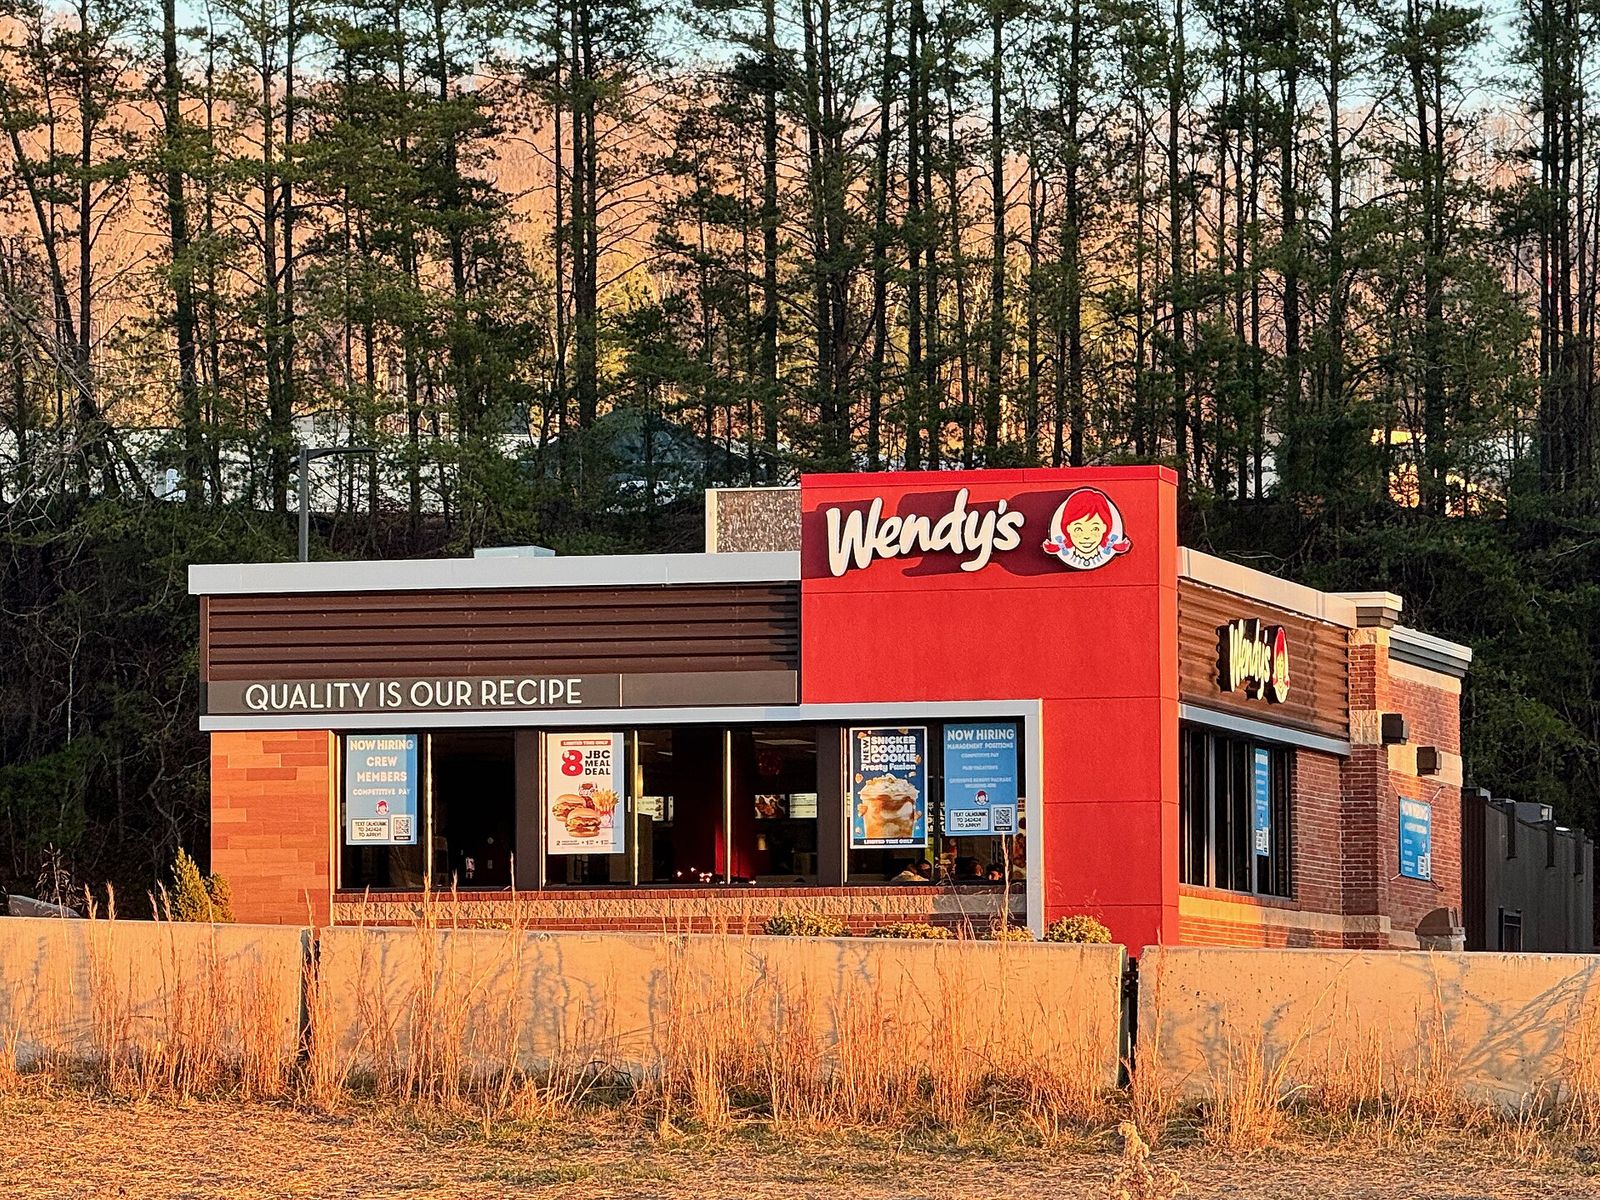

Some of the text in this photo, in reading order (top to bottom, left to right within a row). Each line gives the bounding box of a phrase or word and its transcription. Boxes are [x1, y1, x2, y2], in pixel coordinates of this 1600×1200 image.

[826, 487, 1025, 577] Wendy's
[1229, 618, 1271, 700] Wendy's
[245, 679, 582, 711] QUALITY IS OUR RECIPE
[870, 735, 916, 744] SNICKER
[947, 729, 1015, 741] NOW HIRING
[350, 739, 414, 751] NOW HIRING
[862, 738, 870, 761] NEW
[870, 744, 916, 753] DOODLE
[585, 750, 611, 759] JBC
[871, 753, 916, 763] COOKIE
[366, 756, 398, 767] CREW
[561, 749, 584, 776] 8
[861, 762, 916, 772] Frosty Fusion
[356, 771, 408, 782] MEMBERS
[585, 768, 611, 776] DEAL
[352, 788, 396, 796] COMPETITIVE
